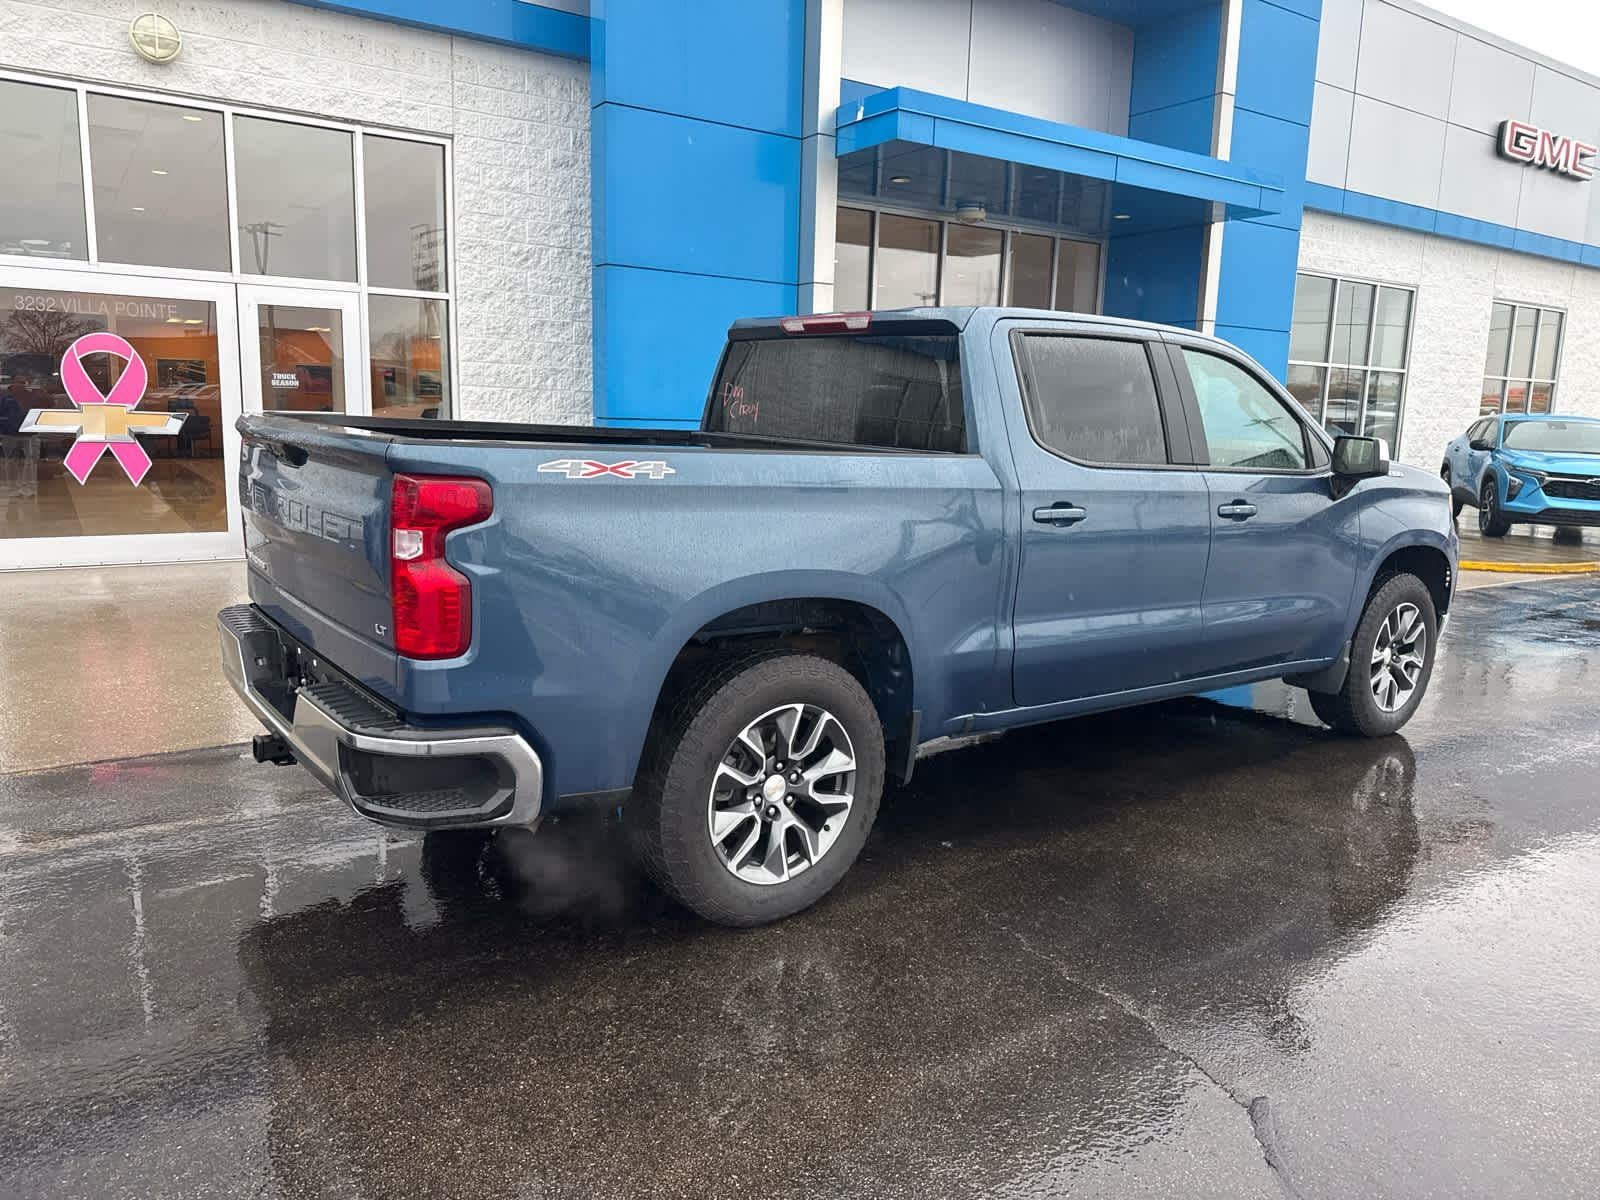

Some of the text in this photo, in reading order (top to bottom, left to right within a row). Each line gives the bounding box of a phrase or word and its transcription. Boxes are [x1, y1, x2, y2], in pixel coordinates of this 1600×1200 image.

[1502, 120, 1597, 180] GMC
[15, 295, 178, 319] 3232 VILLA POINTE
[248, 482, 363, 546] EVROLET
[374, 623, 388, 636] LT
